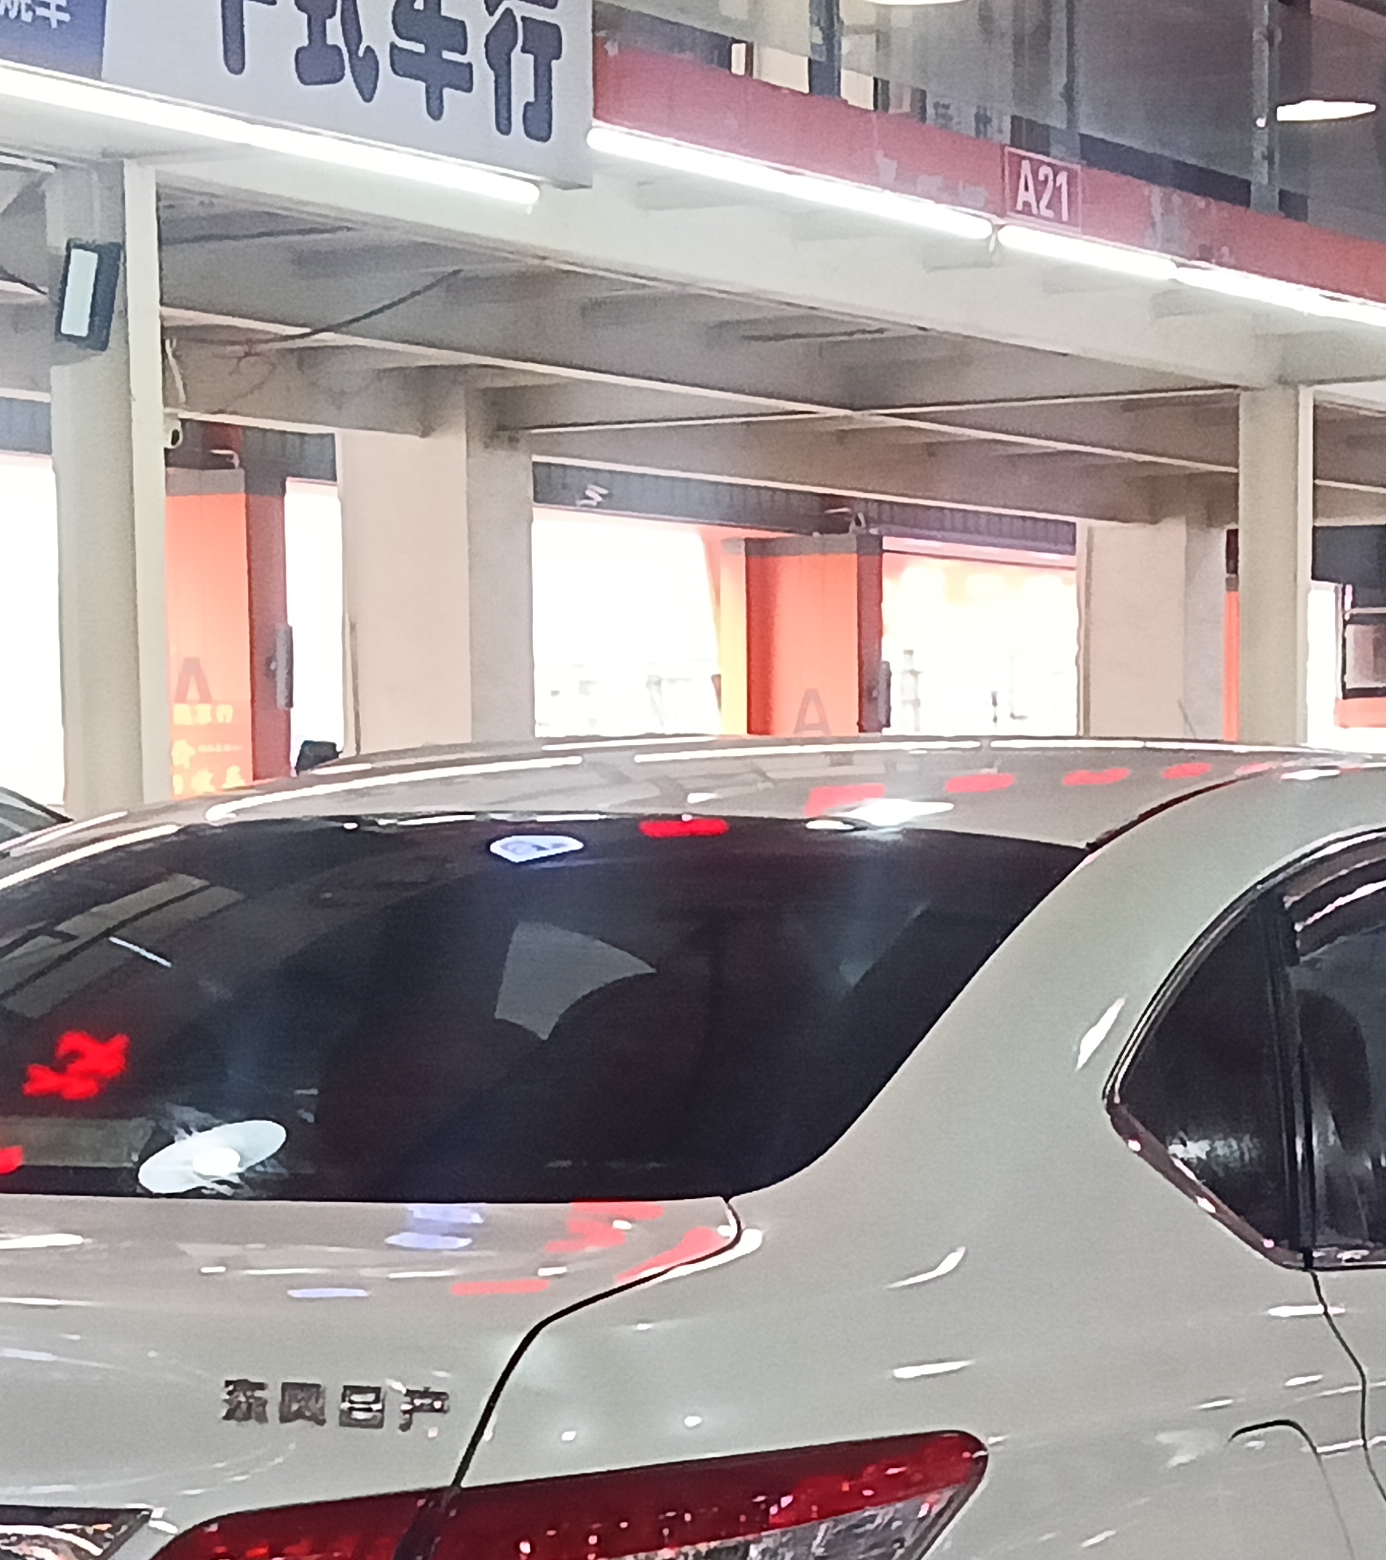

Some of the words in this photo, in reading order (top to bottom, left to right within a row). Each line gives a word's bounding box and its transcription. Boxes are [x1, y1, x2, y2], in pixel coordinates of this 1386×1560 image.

[1015, 158, 1070, 223] A21
[792, 686, 832, 737] A
[221, 1378, 451, 1432] 东风日产
